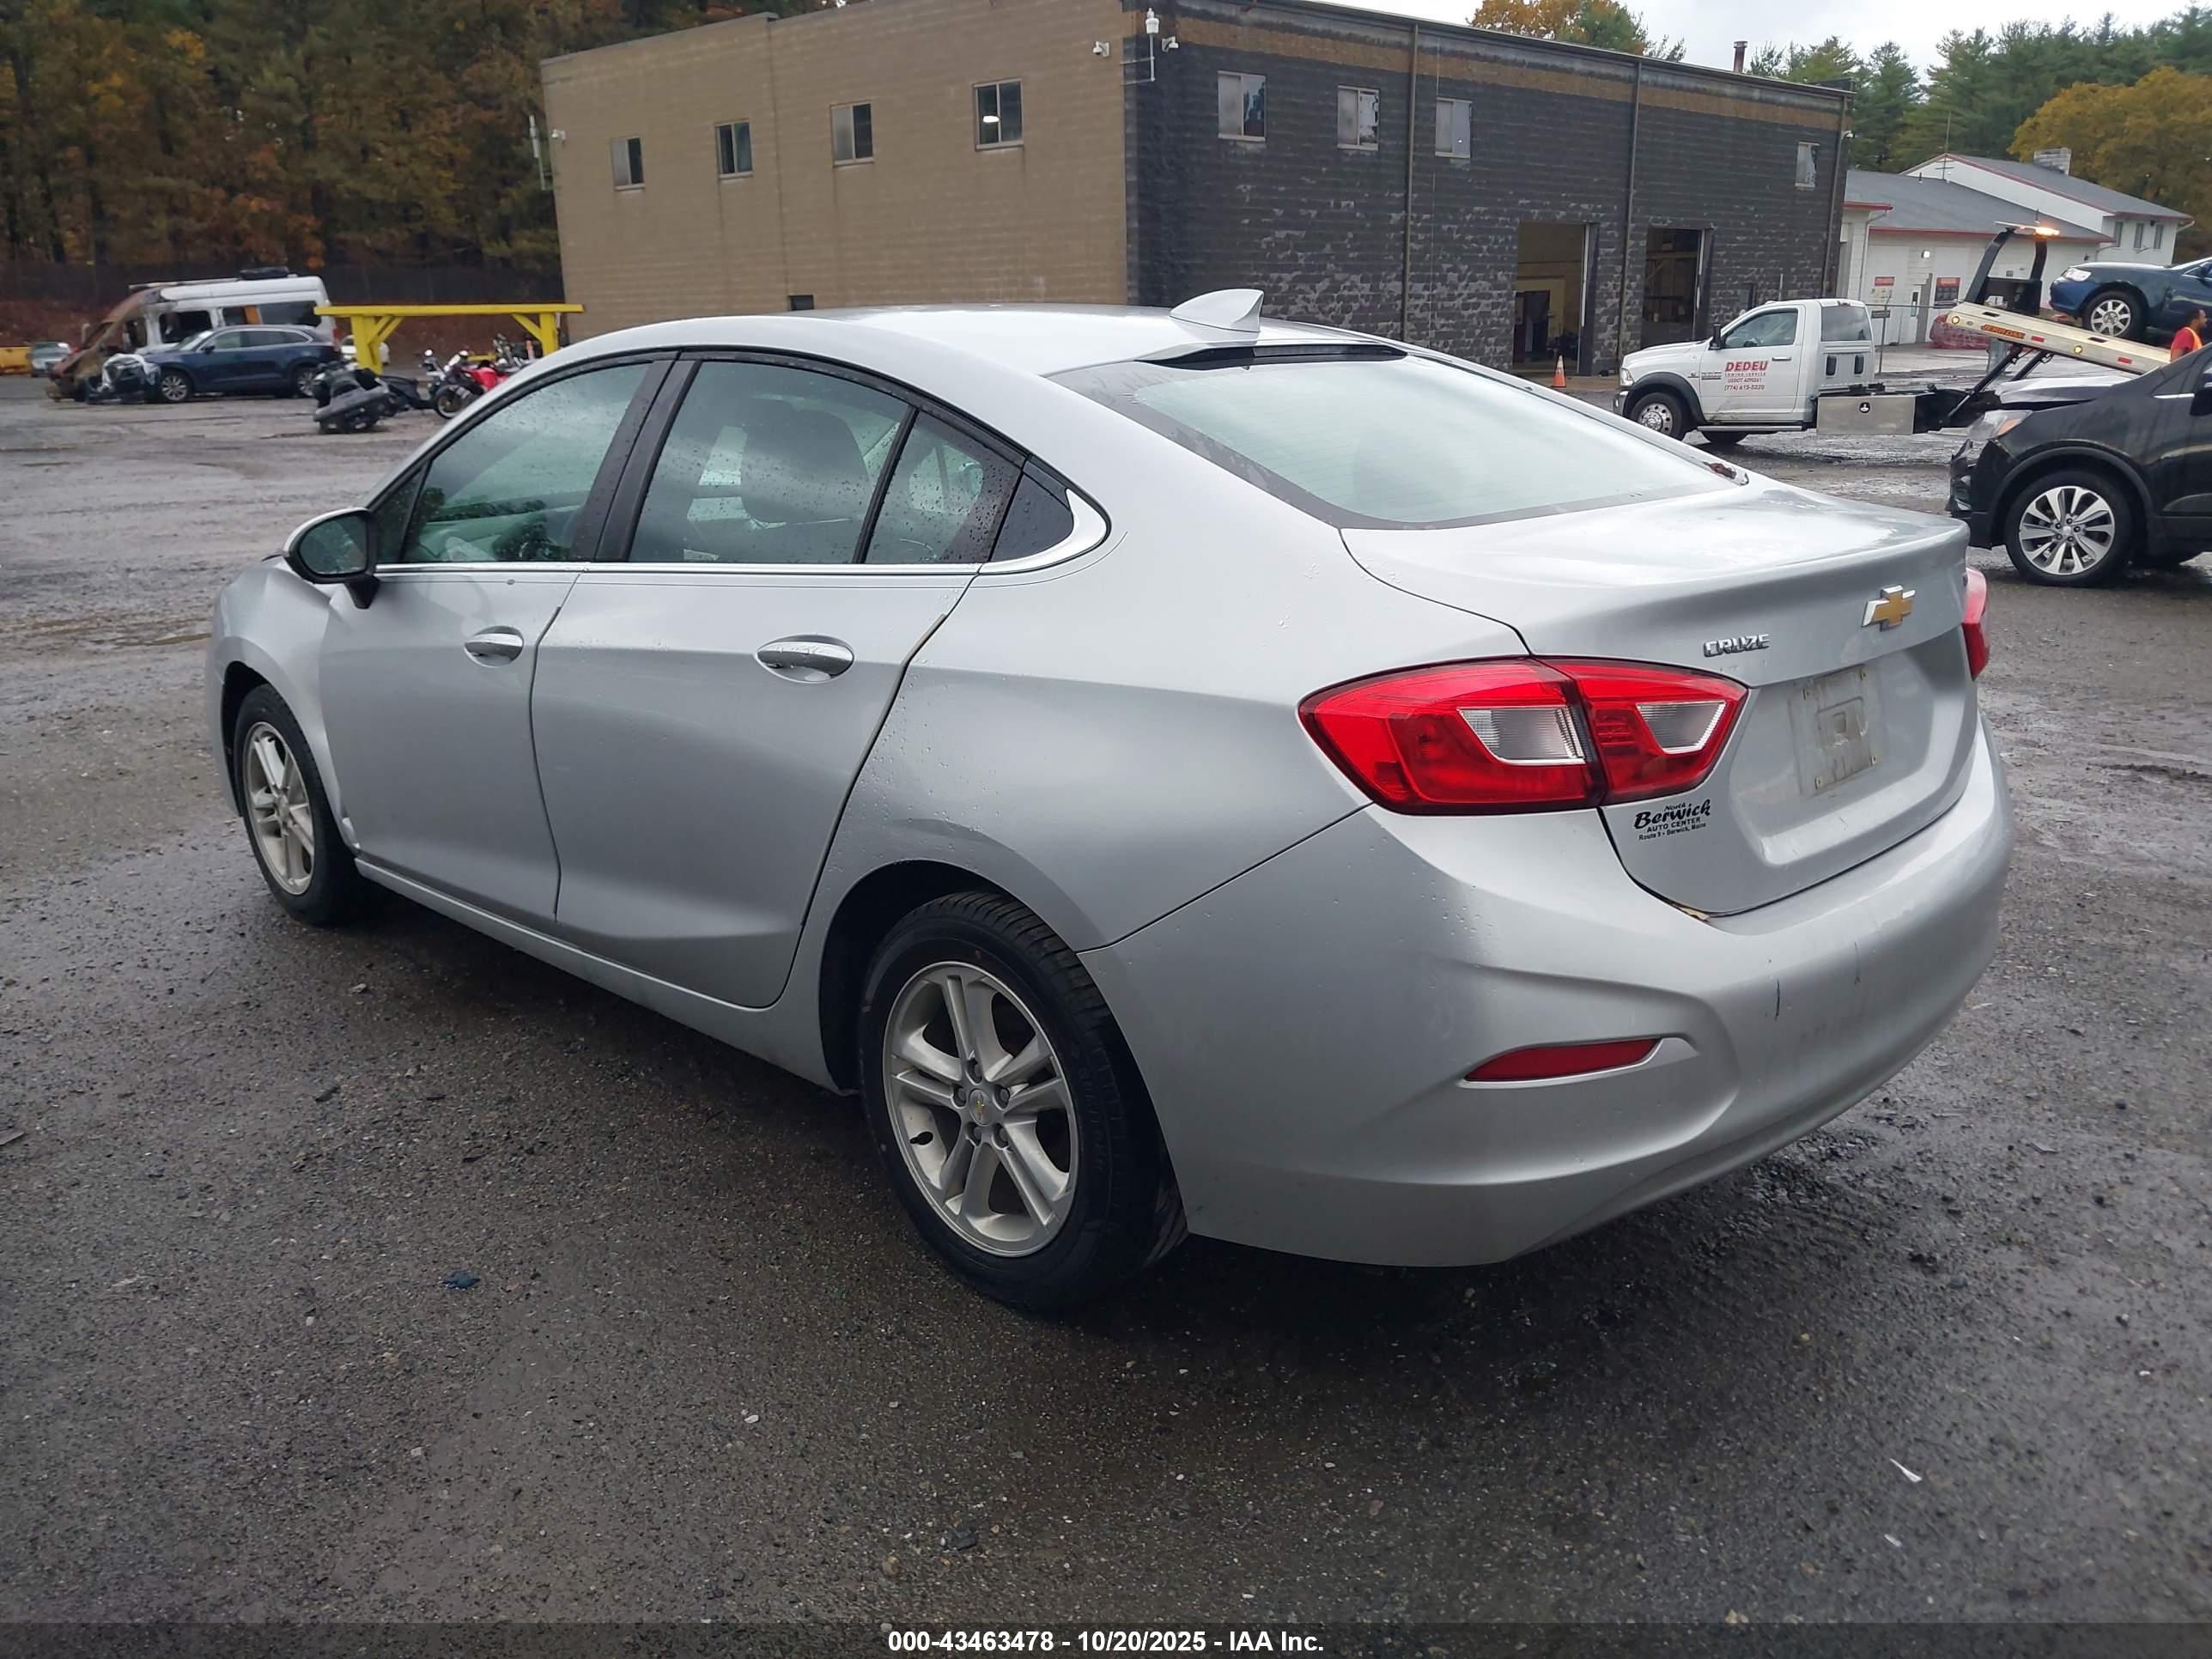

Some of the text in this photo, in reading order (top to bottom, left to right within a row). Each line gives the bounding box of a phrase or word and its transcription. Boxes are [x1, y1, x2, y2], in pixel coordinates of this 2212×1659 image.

[1725, 361, 1768, 371] DEDEU
[1704, 635, 1769, 657] CRUZE
[1664, 802, 1686, 811] North
[1634, 799, 1711, 830] Berwick
[1647, 817, 1701, 833] AUTO CENTER
[1639, 832, 1656, 841] Route
